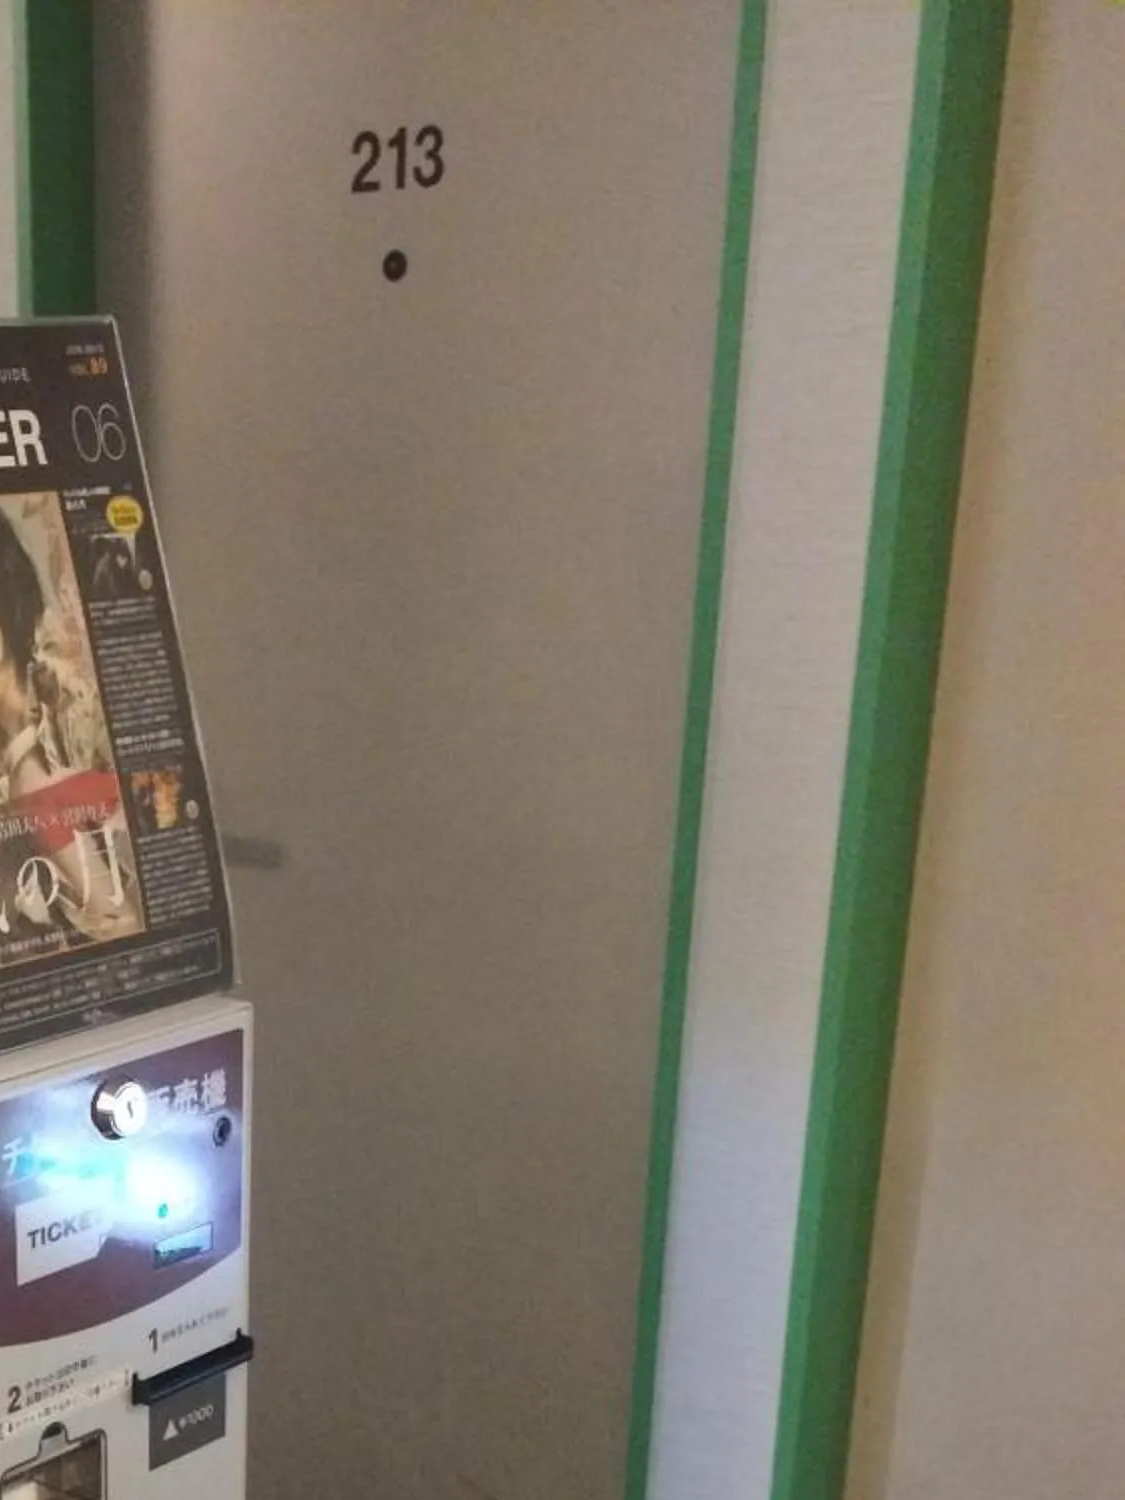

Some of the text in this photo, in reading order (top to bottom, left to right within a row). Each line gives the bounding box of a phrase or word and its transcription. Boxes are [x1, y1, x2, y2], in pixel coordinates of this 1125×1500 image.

[351, 124, 445, 193] 213
[71, 403, 127, 463] 06
[26, 1208, 102, 1250] TICKE
[148, 1327, 158, 1354] 1
[7, 1385, 22, 1414] 2
